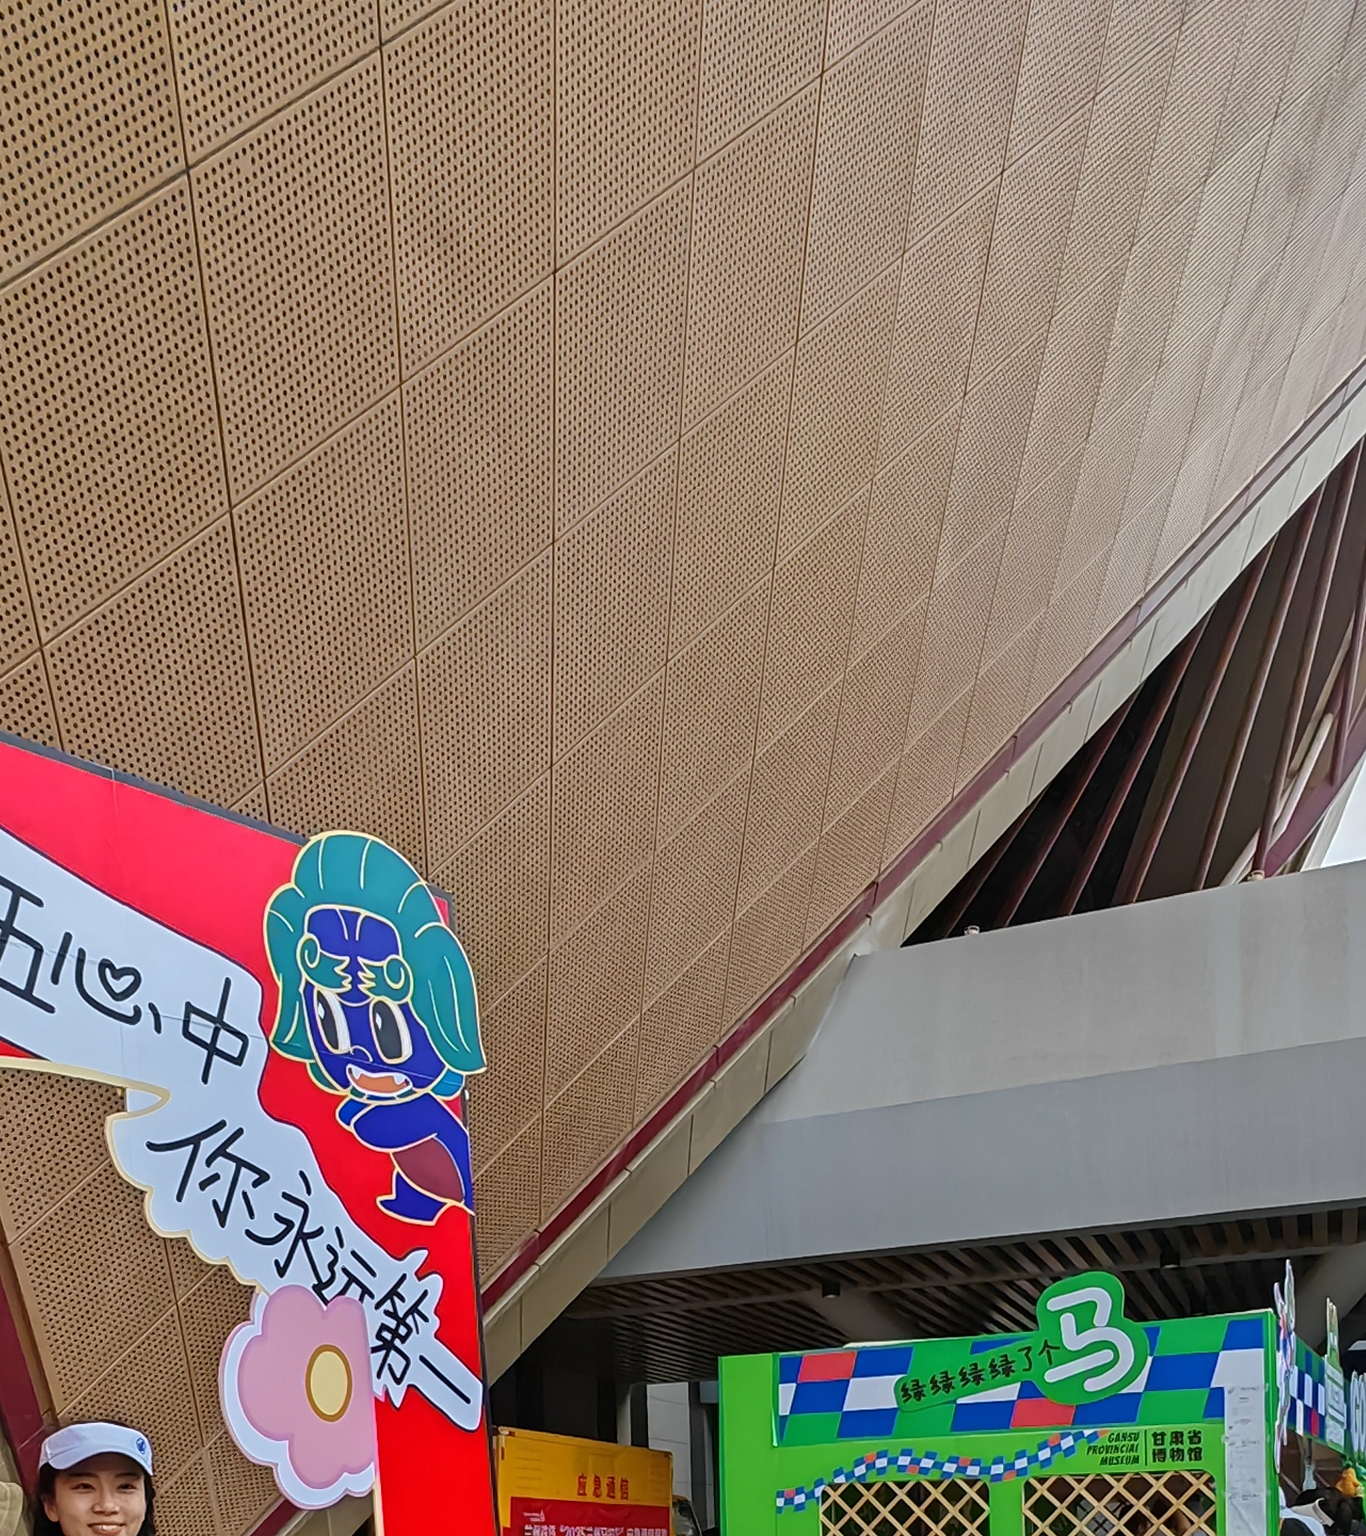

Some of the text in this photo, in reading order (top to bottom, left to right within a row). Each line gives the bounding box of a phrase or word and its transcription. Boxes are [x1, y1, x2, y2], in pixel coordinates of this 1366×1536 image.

[1044, 1287, 1135, 1392] 马
[1107, 1432, 1140, 1443] GANSU
[1151, 1429, 1203, 1446] 甘肃省
[1099, 1455, 1140, 1466] MUSEUM
[1151, 1446, 1203, 1463] 博物馆
[577, 1473, 629, 1500] 应急通信
